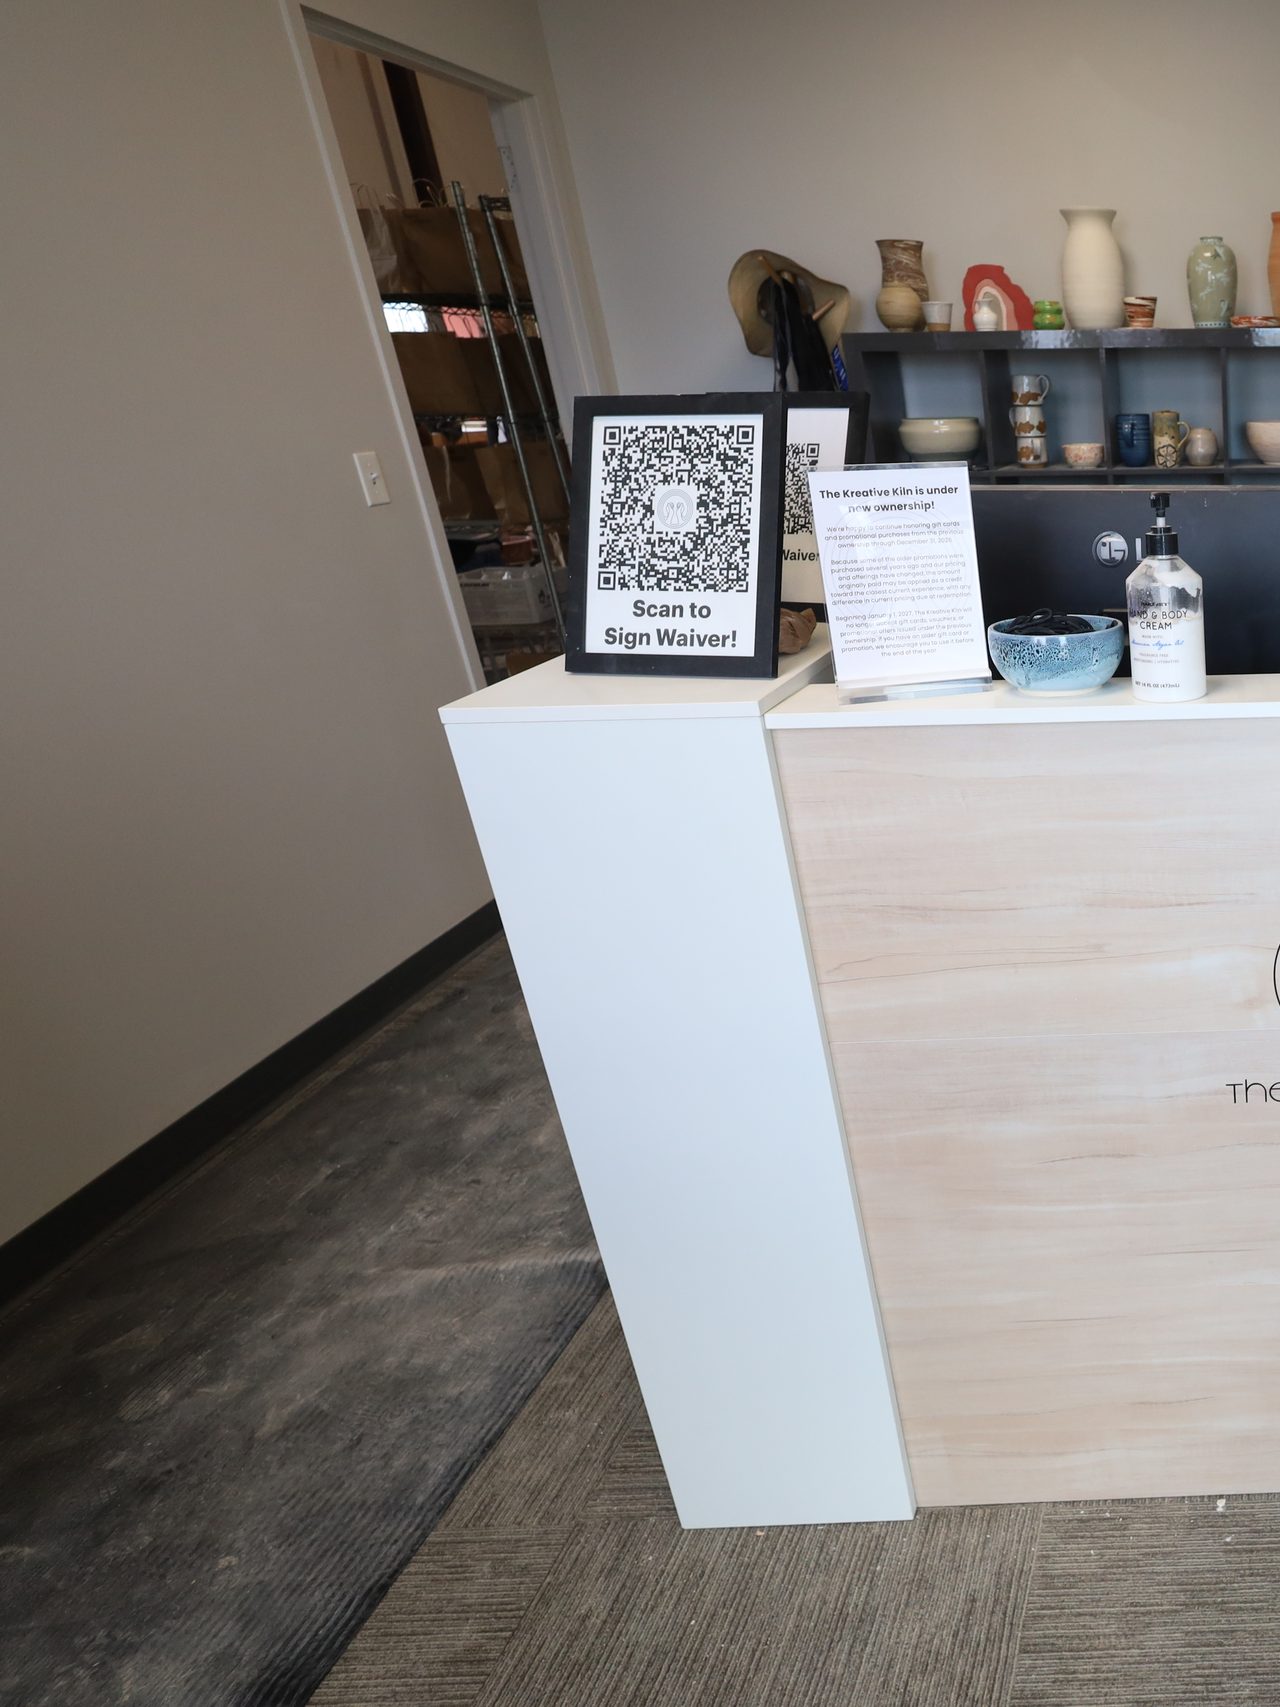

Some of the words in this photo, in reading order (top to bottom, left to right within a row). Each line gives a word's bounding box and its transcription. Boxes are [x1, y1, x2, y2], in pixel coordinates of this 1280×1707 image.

[819, 489, 841, 499] The
[843, 487, 890, 498] Kreative
[892, 486, 913, 496] Kiln
[915, 486, 924, 495] is
[926, 485, 958, 495] under
[873, 500, 935, 515] ownership!
[632, 599, 683, 618] Scan
[690, 601, 712, 618] to
[1151, 611, 1158, 619] &
[1162, 610, 1188, 619] BODY
[1139, 621, 1172, 630] CREAM
[604, 627, 651, 650] Sign
[656, 627, 737, 648] Waiver!
